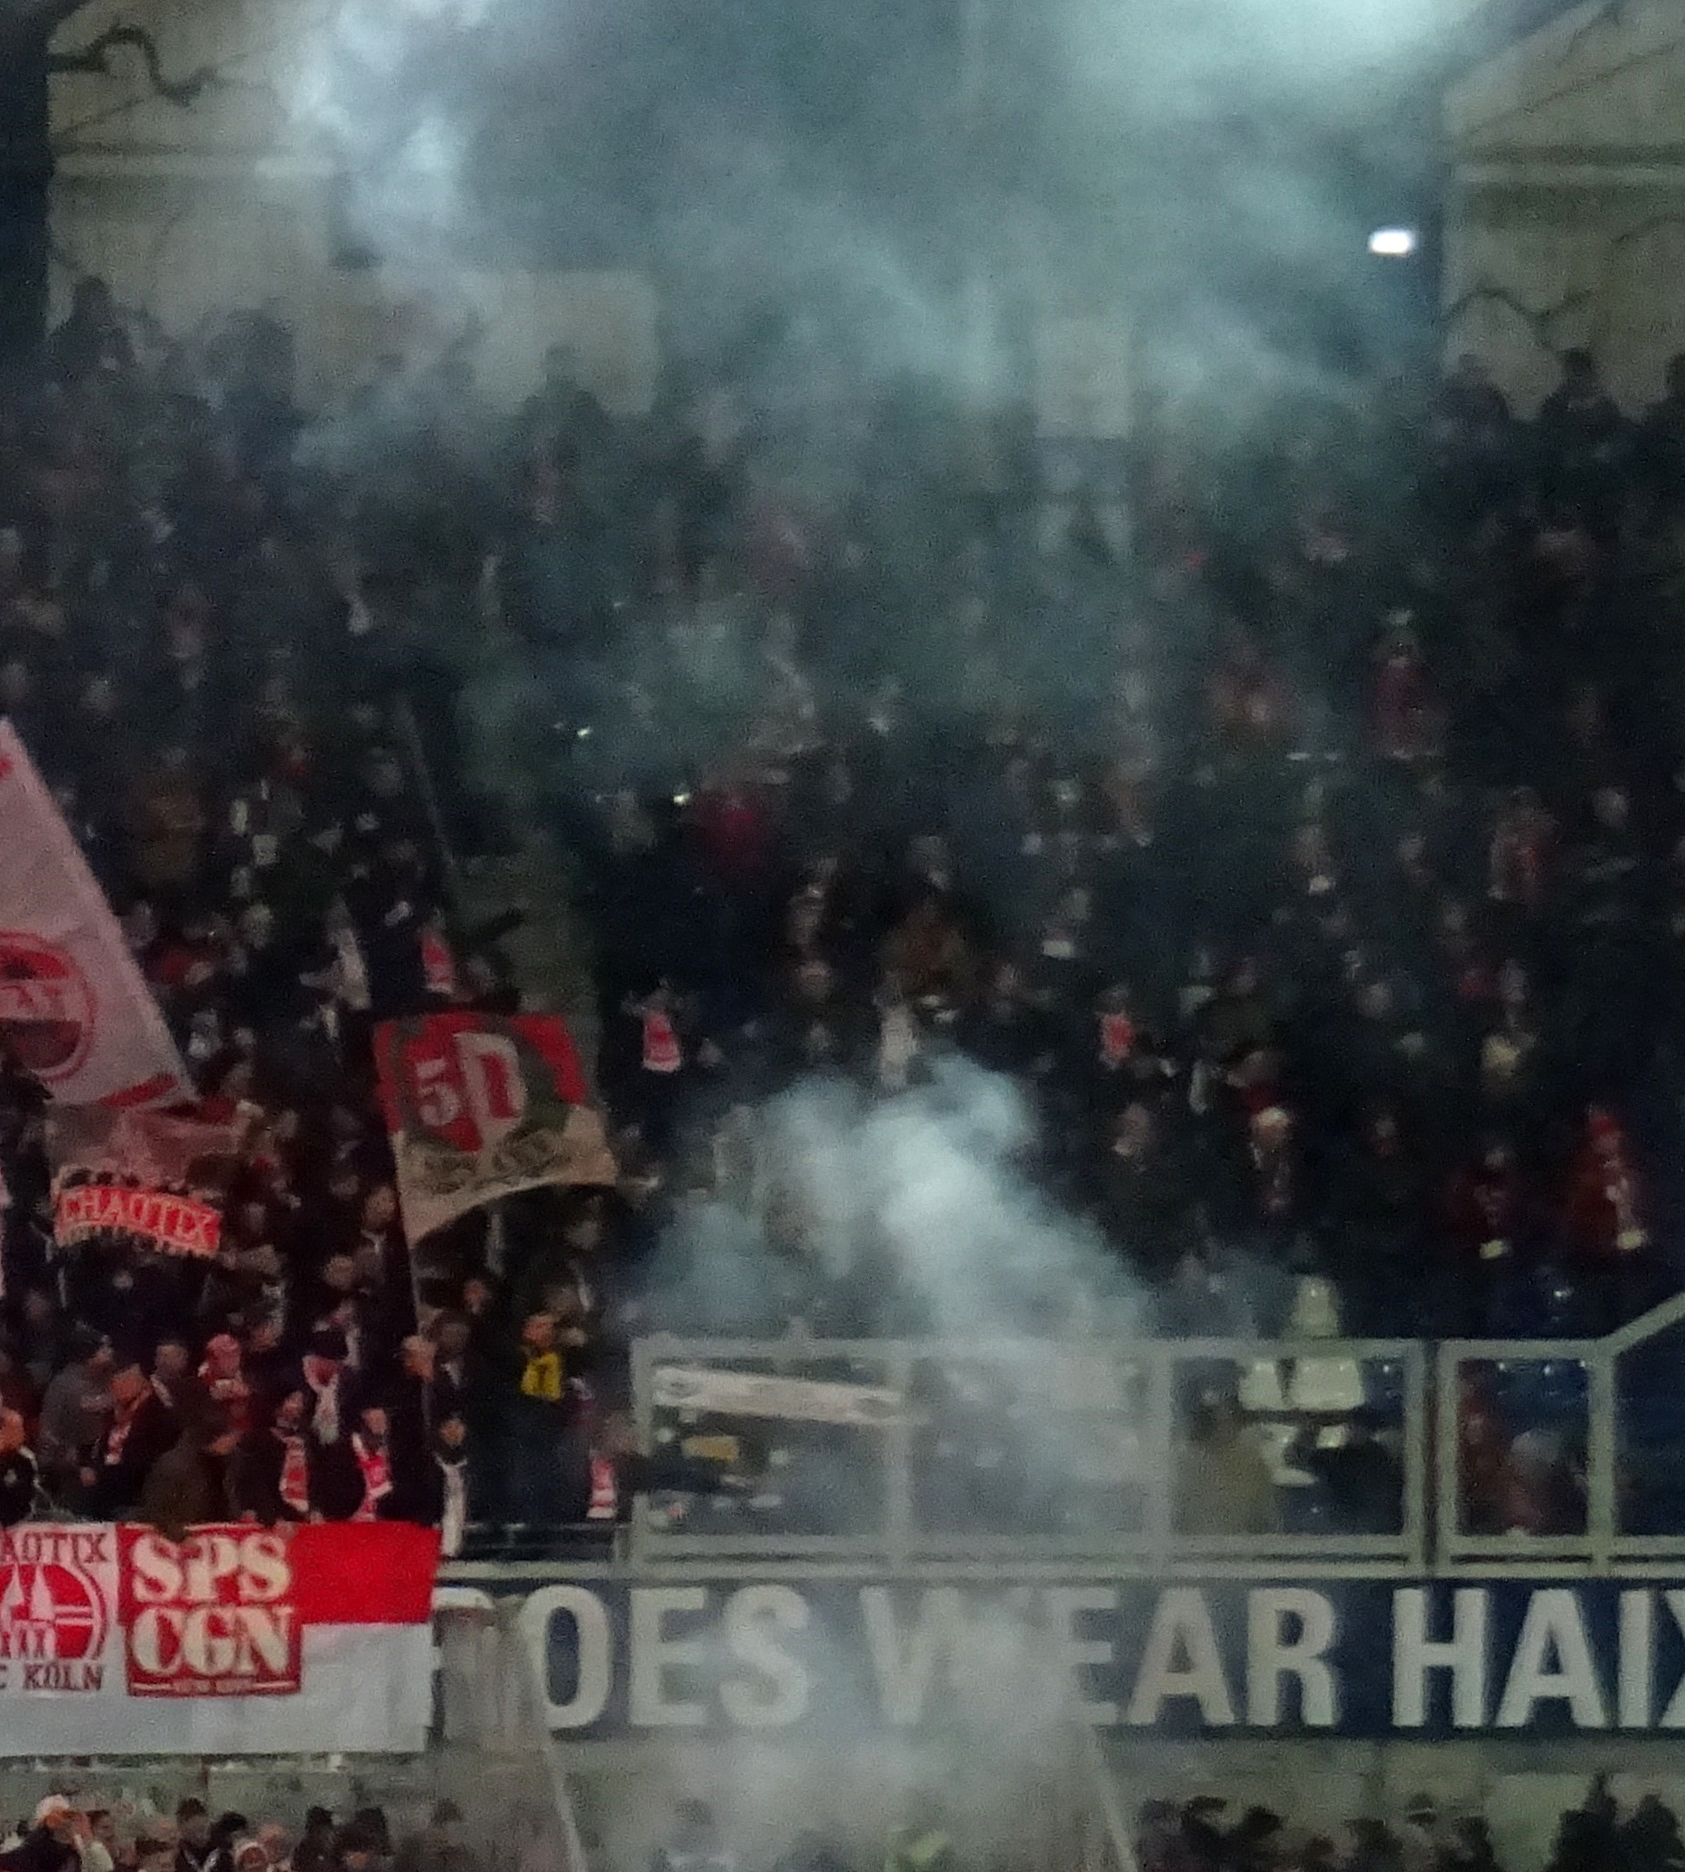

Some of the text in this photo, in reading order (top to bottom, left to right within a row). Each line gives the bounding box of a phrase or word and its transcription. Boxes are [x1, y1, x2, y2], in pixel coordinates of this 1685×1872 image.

[133, 1535, 292, 1600] SPS
[133, 1607, 292, 1675] CGN
[432, 1585, 810, 1727] OES
[857, 1586, 1341, 1728] WEAR
[25, 1663, 104, 1692] KÖLN
